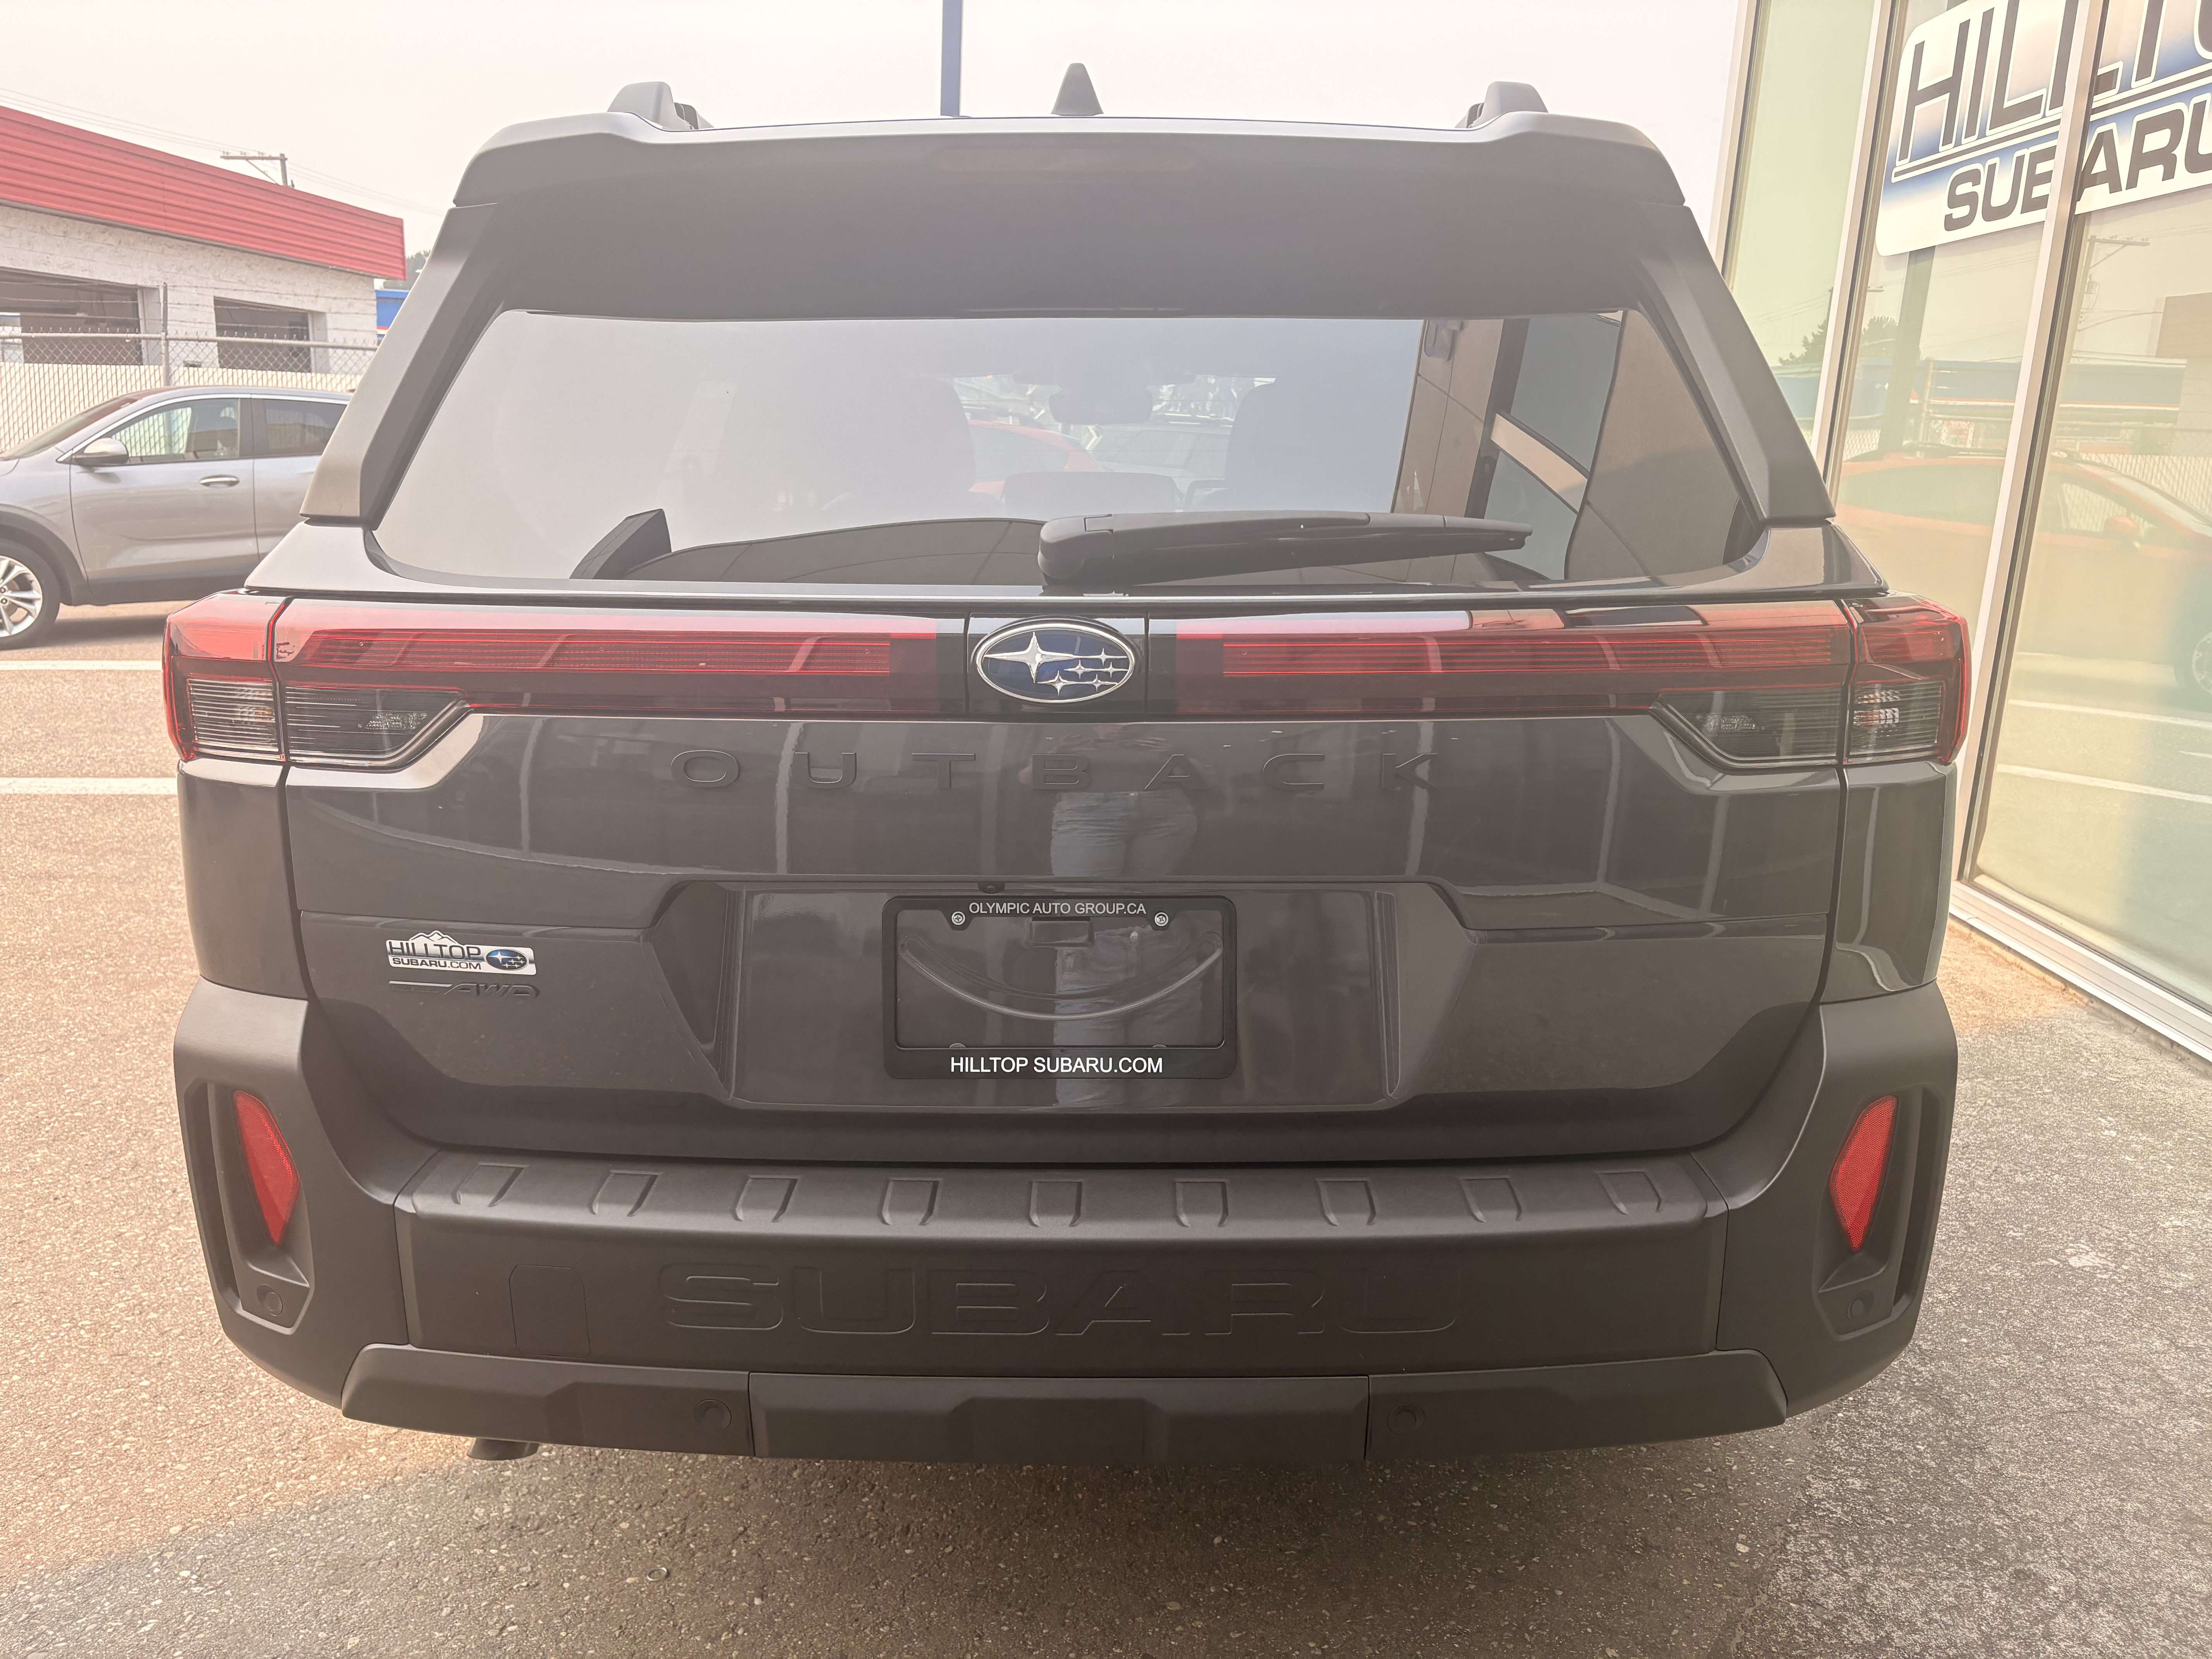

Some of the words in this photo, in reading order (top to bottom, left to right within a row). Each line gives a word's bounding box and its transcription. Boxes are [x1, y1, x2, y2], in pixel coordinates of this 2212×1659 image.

[1898, 0, 2212, 162] HILL
[670, 749, 1439, 792] OUTBACK
[969, 902, 1030, 914] OLYMPIC
[1032, 902, 1071, 914] AUTO
[1075, 903, 1147, 915] GROUP.CA
[388, 941, 481, 960] HILLTOP
[392, 957, 481, 970] SUBARU.COM
[444, 982, 540, 999] AWD
[950, 1056, 1029, 1073] HILLTOP
[1033, 1056, 1163, 1073] SUBARU.COM
[657, 1261, 1463, 1337] SUBARU
